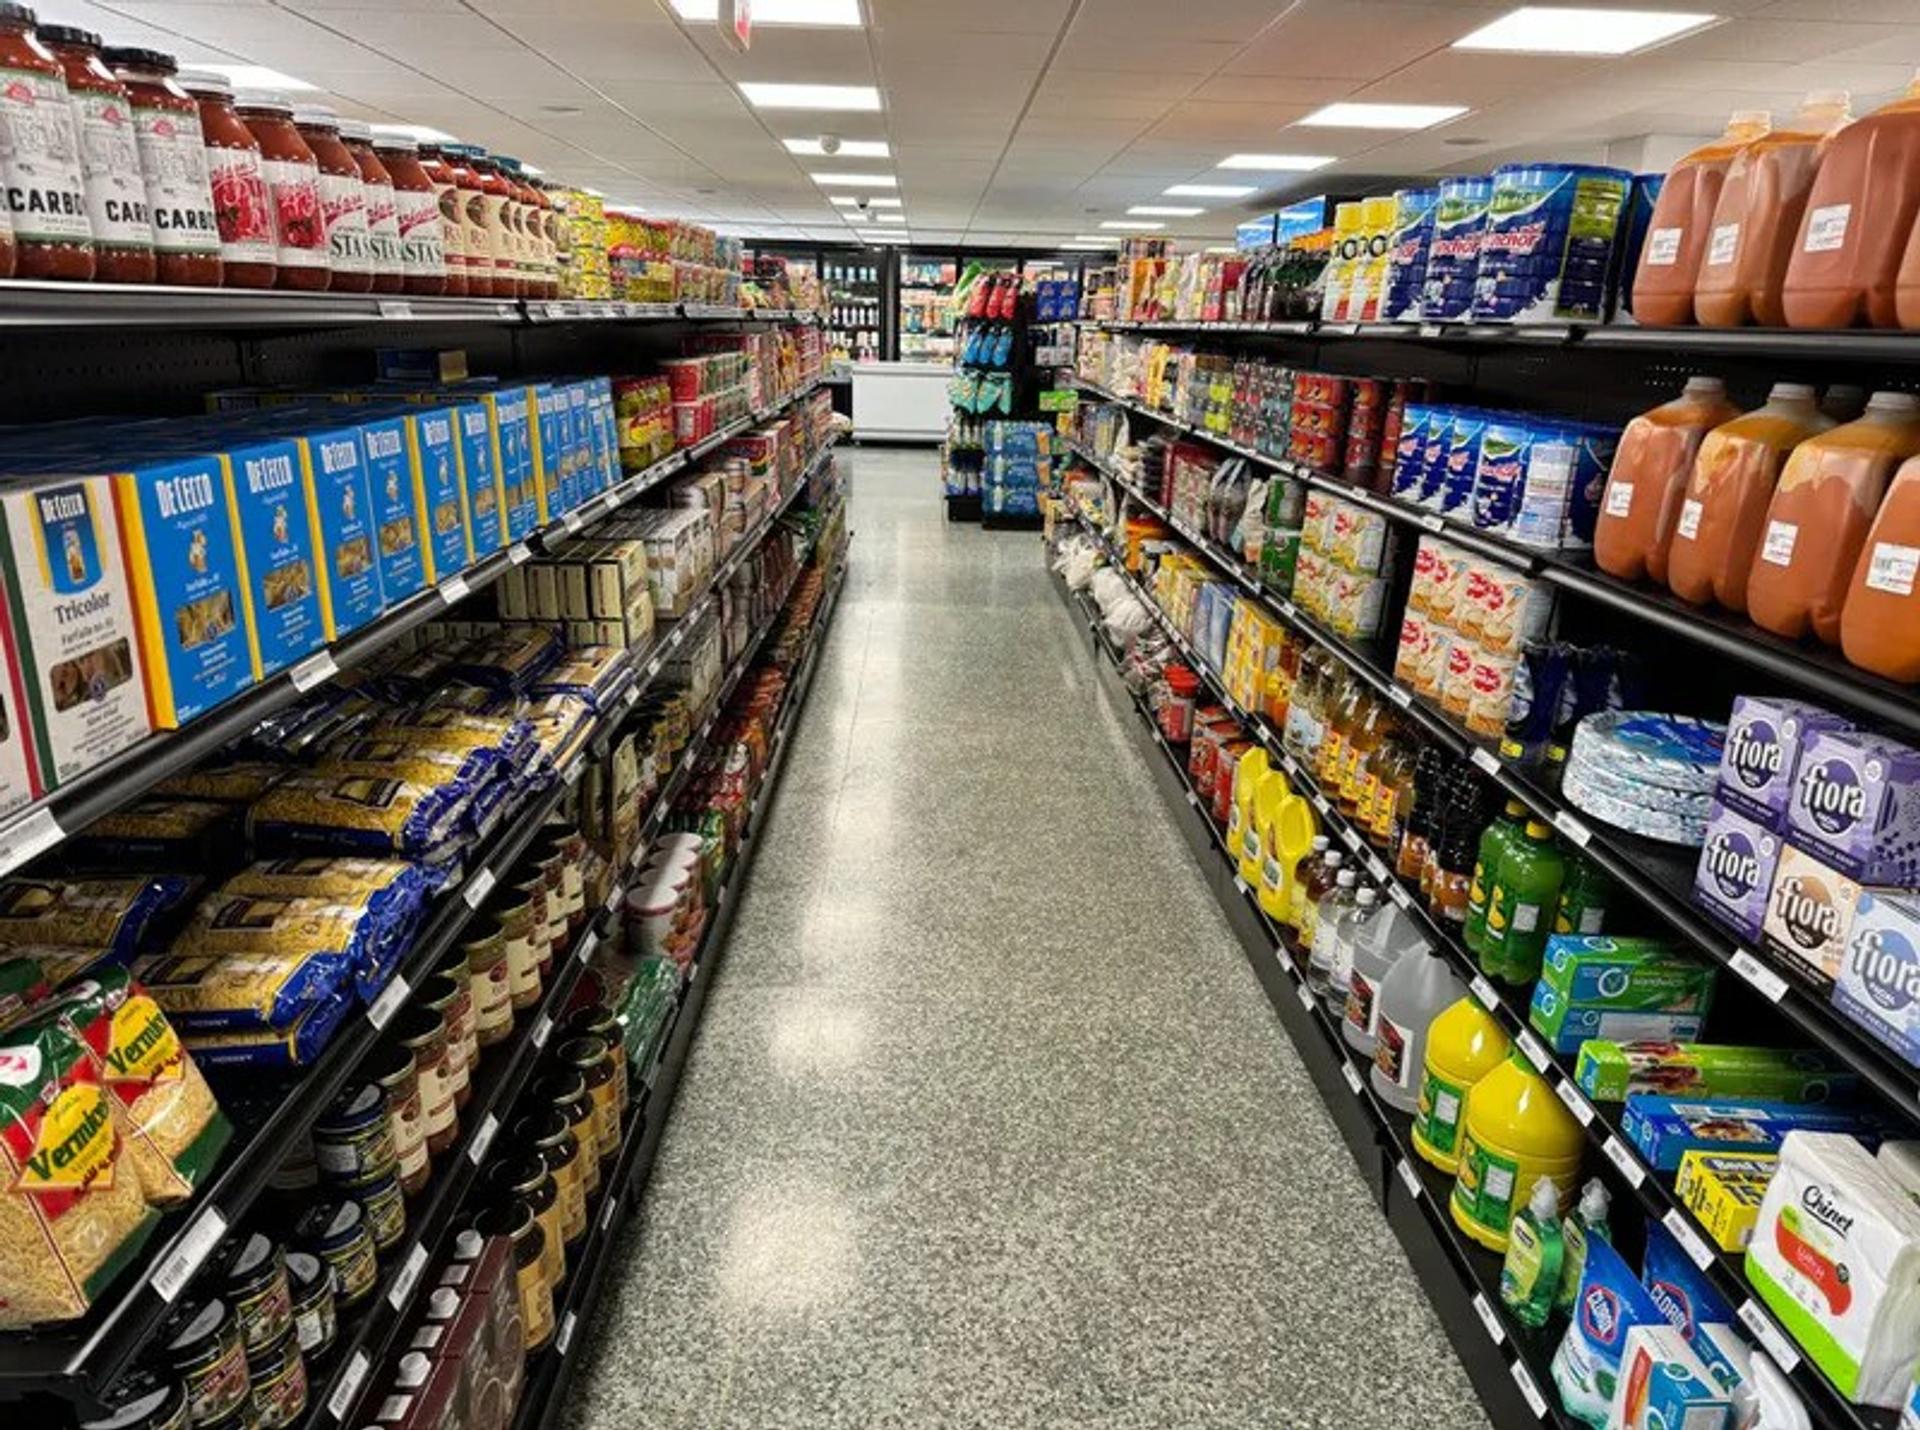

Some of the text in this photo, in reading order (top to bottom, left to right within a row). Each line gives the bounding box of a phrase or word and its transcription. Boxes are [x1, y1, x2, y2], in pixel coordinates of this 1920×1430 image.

[55, 593, 110, 624] Tricolor
[1733, 727, 1782, 772] fiora
[1804, 765, 1866, 818] fiora
[1710, 835, 1760, 887] fiora
[1778, 878, 1838, 937] fiora
[1853, 930, 1920, 998] fiora
[1802, 1185, 1854, 1233] Chinet
